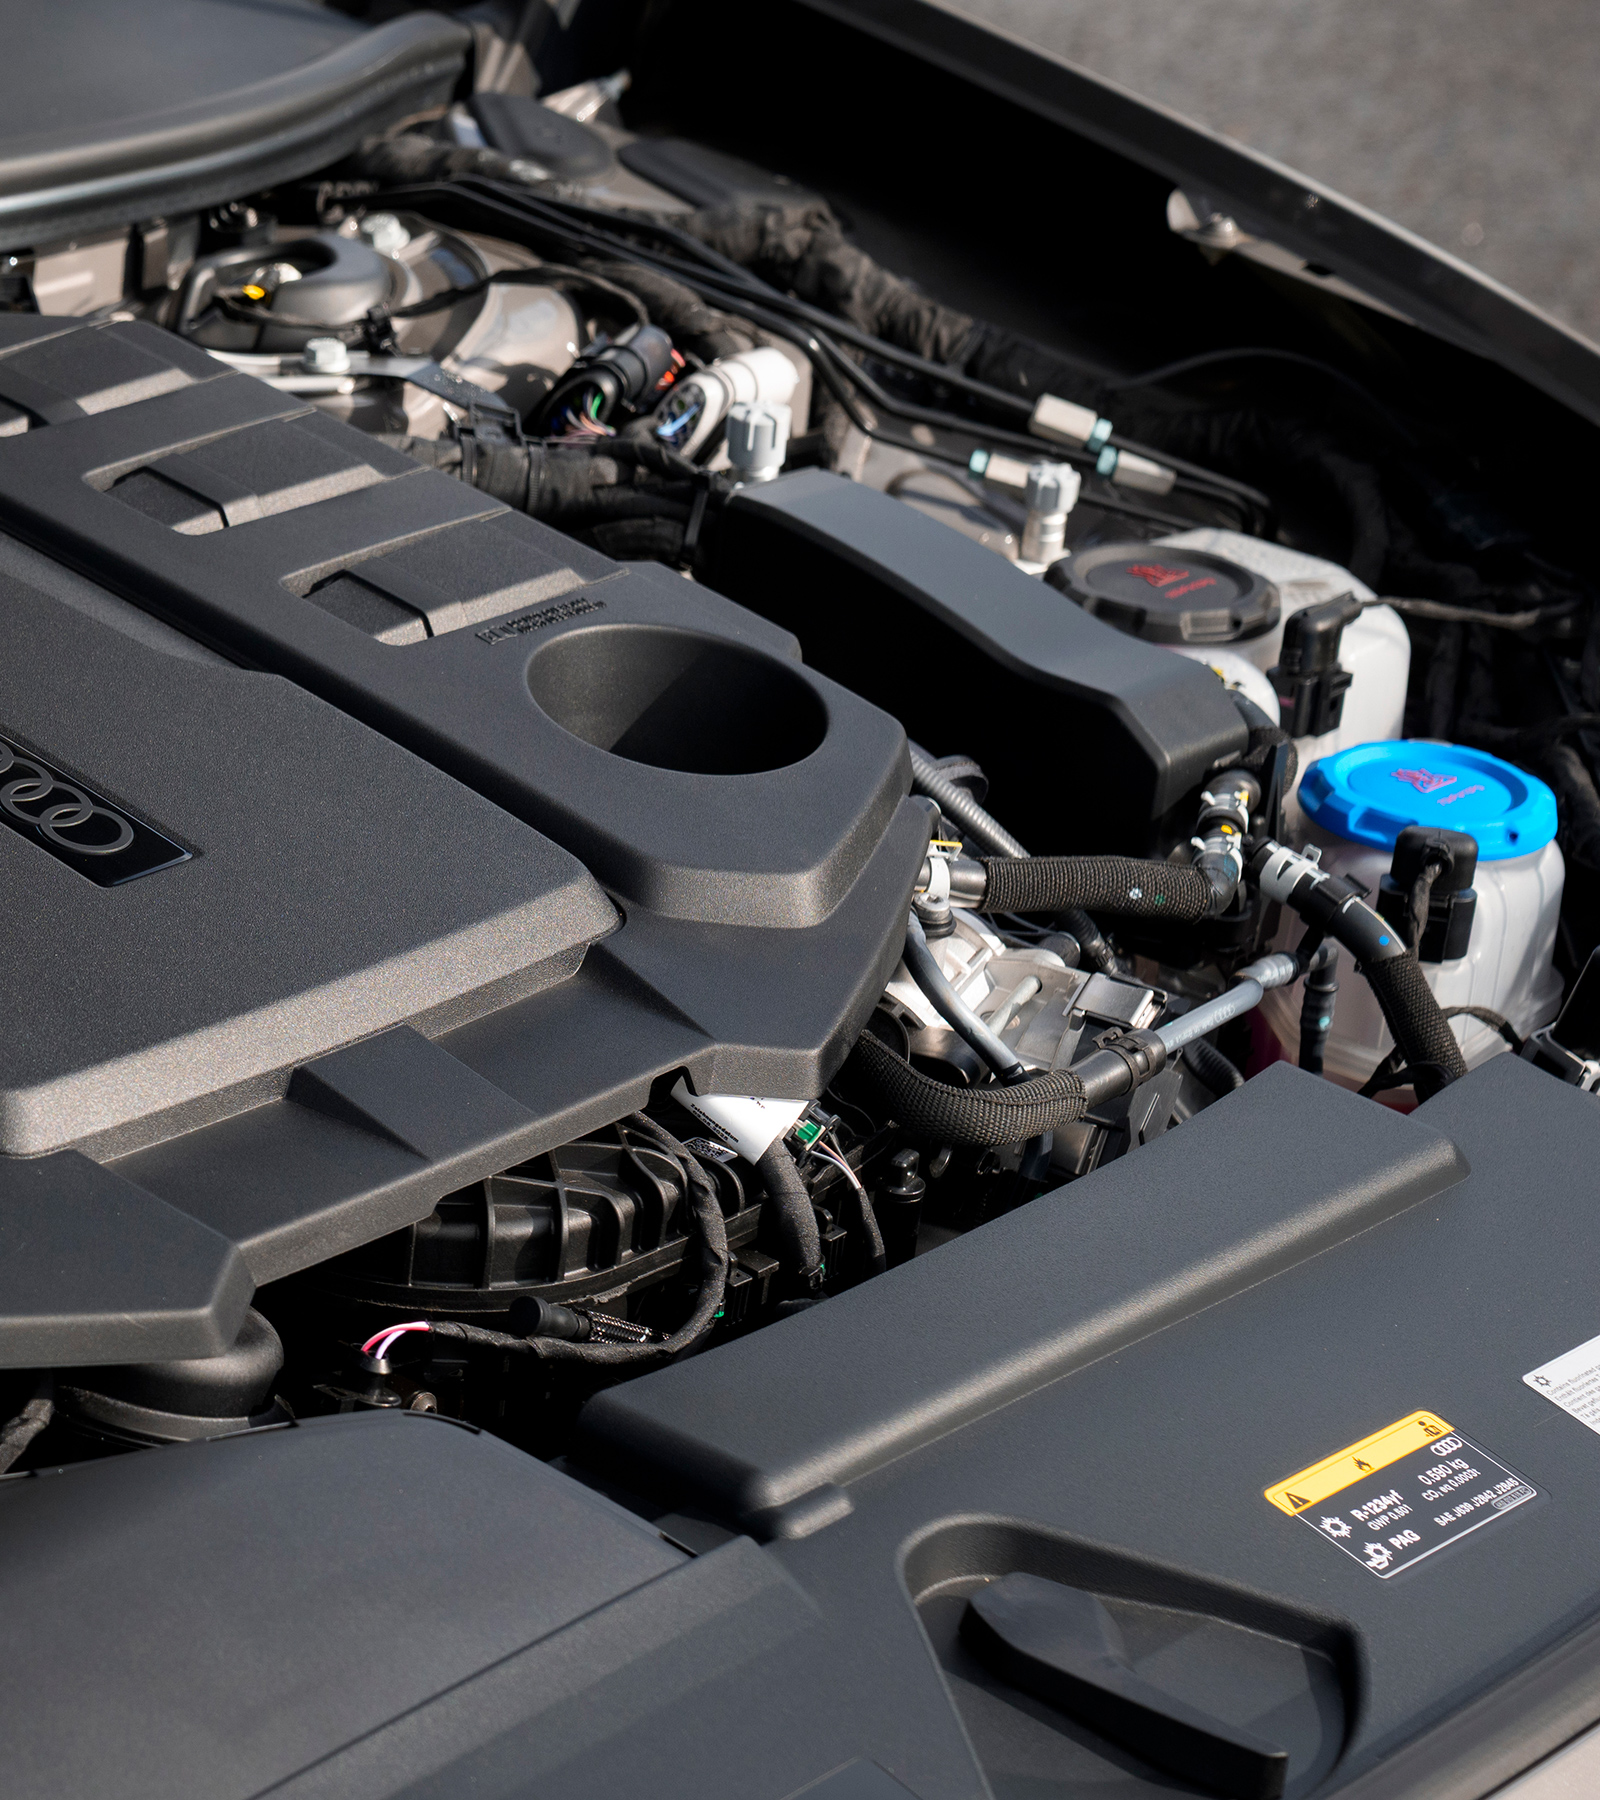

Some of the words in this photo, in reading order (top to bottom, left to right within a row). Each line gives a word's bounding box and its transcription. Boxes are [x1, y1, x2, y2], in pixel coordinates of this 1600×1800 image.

[691, 1103, 739, 1143] Zeichnungsdatum
[1546, 1382, 1570, 1395] Contains
[1568, 1368, 1596, 1383] fluorinated
[1564, 1394, 1587, 1407] Contient
[1417, 1464, 1453, 1486] 0.590
[1446, 1458, 1470, 1470] kg
[1433, 1512, 1457, 1527] SAE
[1452, 1502, 1475, 1518] J639
[1470, 1490, 1498, 1507] J2842
[1492, 1478, 1520, 1495] J2845
[1438, 1484, 1455, 1494] eq
[1350, 1489, 1404, 1522] R-1234yf
[1367, 1514, 1391, 1531] GWP
[1387, 1504, 1414, 1520] 0.501
[1388, 1529, 1421, 1550] PAG
